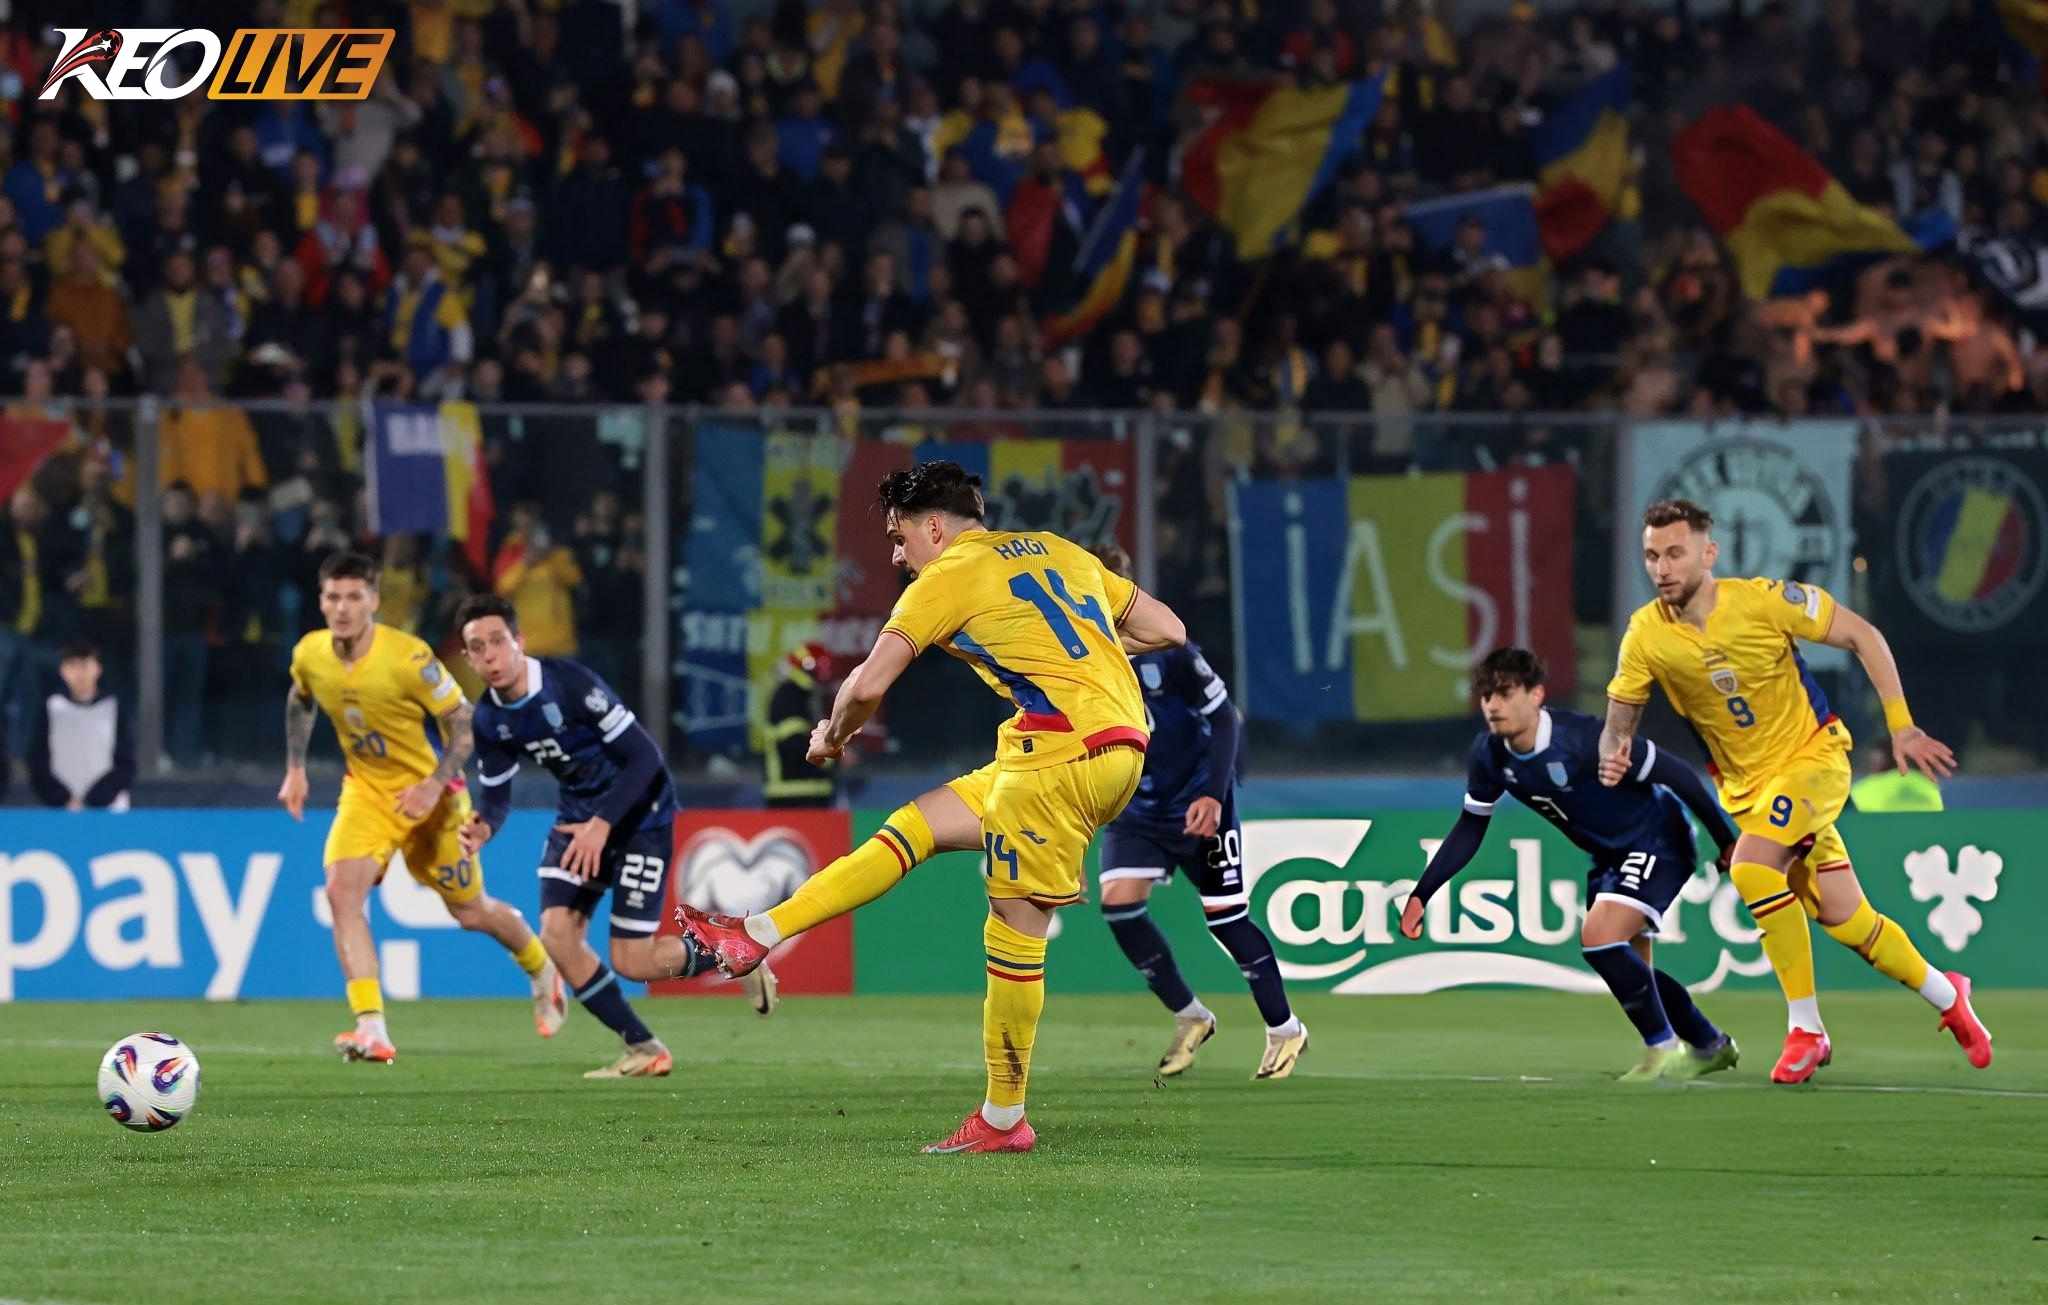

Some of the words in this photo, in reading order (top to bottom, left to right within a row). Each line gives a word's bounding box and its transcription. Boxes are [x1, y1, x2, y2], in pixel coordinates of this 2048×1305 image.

[993, 538, 1049, 560] HAGI
[1008, 568, 1116, 660] 14
[1727, 696, 1755, 728] 9
[350, 730, 386, 758] 20
[1769, 794, 1793, 828] 9
[985, 831, 1018, 881] 14
[1207, 829, 1240, 868] 20
[437, 859, 472, 890] 20
[620, 853, 664, 893] 23
[1620, 852, 1657, 880] 21
